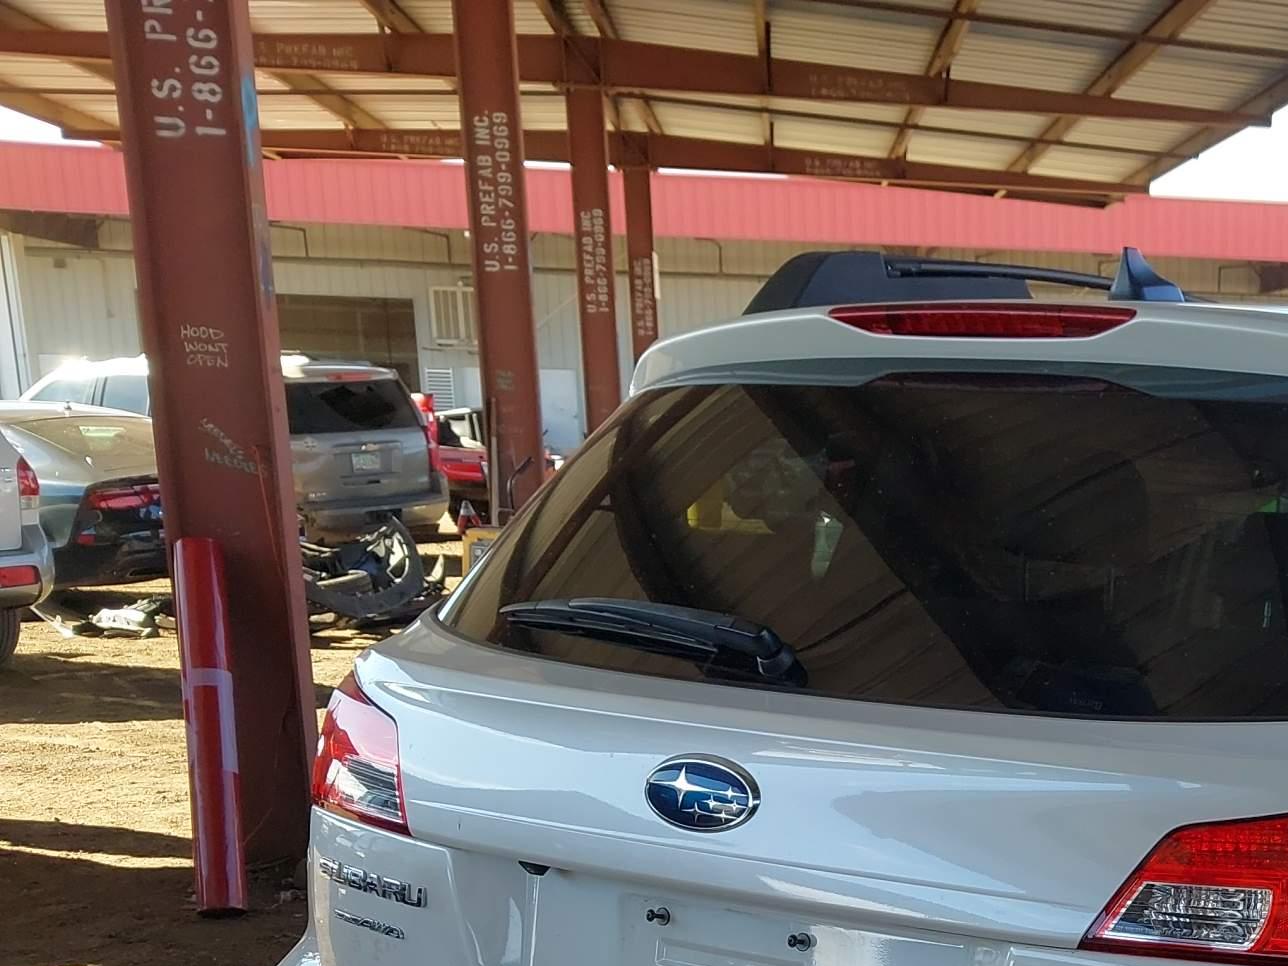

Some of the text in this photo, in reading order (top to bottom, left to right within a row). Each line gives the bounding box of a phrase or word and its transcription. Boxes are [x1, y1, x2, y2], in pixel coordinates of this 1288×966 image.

[151, 66, 187, 137] U.S.
[477, 155, 497, 227] PREFAB
[492, 112, 519, 270] 1-866-799-0969
[484, 237, 501, 272] U.S.
[181, 325, 225, 340] HOOD
[184, 341, 229, 353] WONT
[187, 353, 229, 368] OPEN
[319, 856, 429, 909] SUBARU
